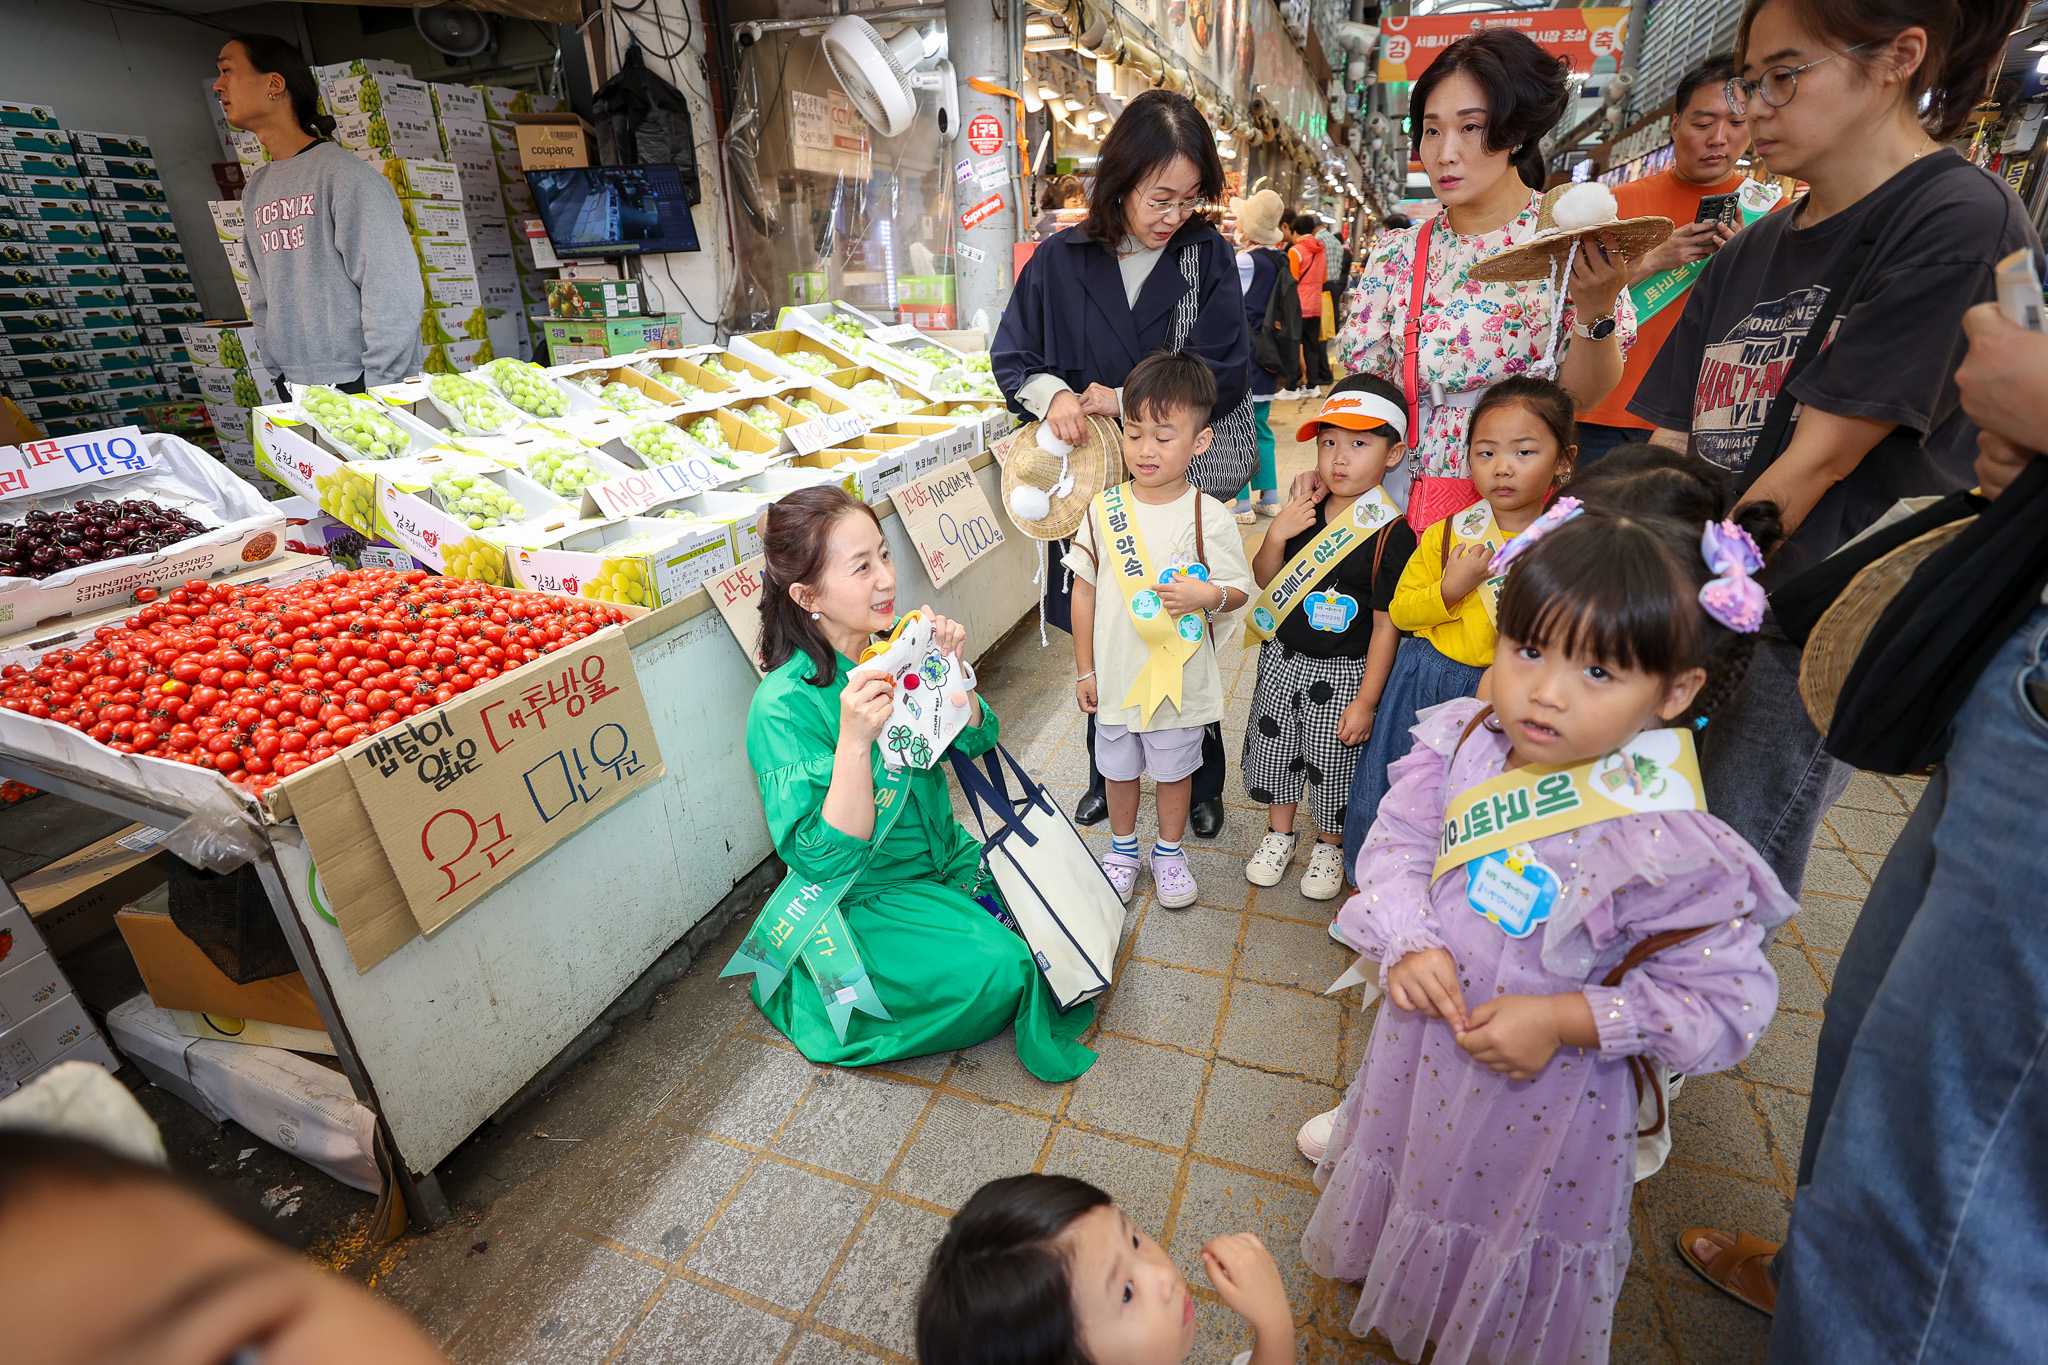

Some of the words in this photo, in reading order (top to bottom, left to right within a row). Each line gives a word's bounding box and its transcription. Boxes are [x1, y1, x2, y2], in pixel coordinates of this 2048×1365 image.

[1389, 41, 1406, 59] 경
[1415, 34, 1449, 48] 서울시
[1561, 28, 1587, 42] 조성
[1595, 30, 1614, 51] 축
[971, 123, 999, 138] 1구역
[530, 144, 575, 157] coupang
[254, 194, 315, 230] KOSMIK
[962, 198, 1001, 226] Supreme
[260, 223, 306, 255] NOISE
[795, 422, 832, 449] 세일
[25, 440, 65, 467] 1근
[64, 437, 152, 476] 만원
[0, 469, 30, 496] 리
[602, 474, 665, 513] 세일
[656, 459, 722, 492] 만원
[897, 482, 931, 516] 고당도
[1103, 485, 1128, 533] 지구랑
[172, 553, 214, 571] CERISES
[920, 542, 951, 581] 1박스
[1115, 534, 1144, 578] 약속
[1313, 527, 1354, 564] 시장
[77, 566, 170, 596] CANADIENNES
[145, 561, 213, 585] CANADIAN
[716, 566, 762, 607] 고당도
[1271, 559, 1316, 611] 나들이
[76, 581, 142, 604] CHERRIES
[479, 655, 620, 754] 대추방울
[417, 738, 483, 792] 얇은
[522, 723, 646, 824] 만원
